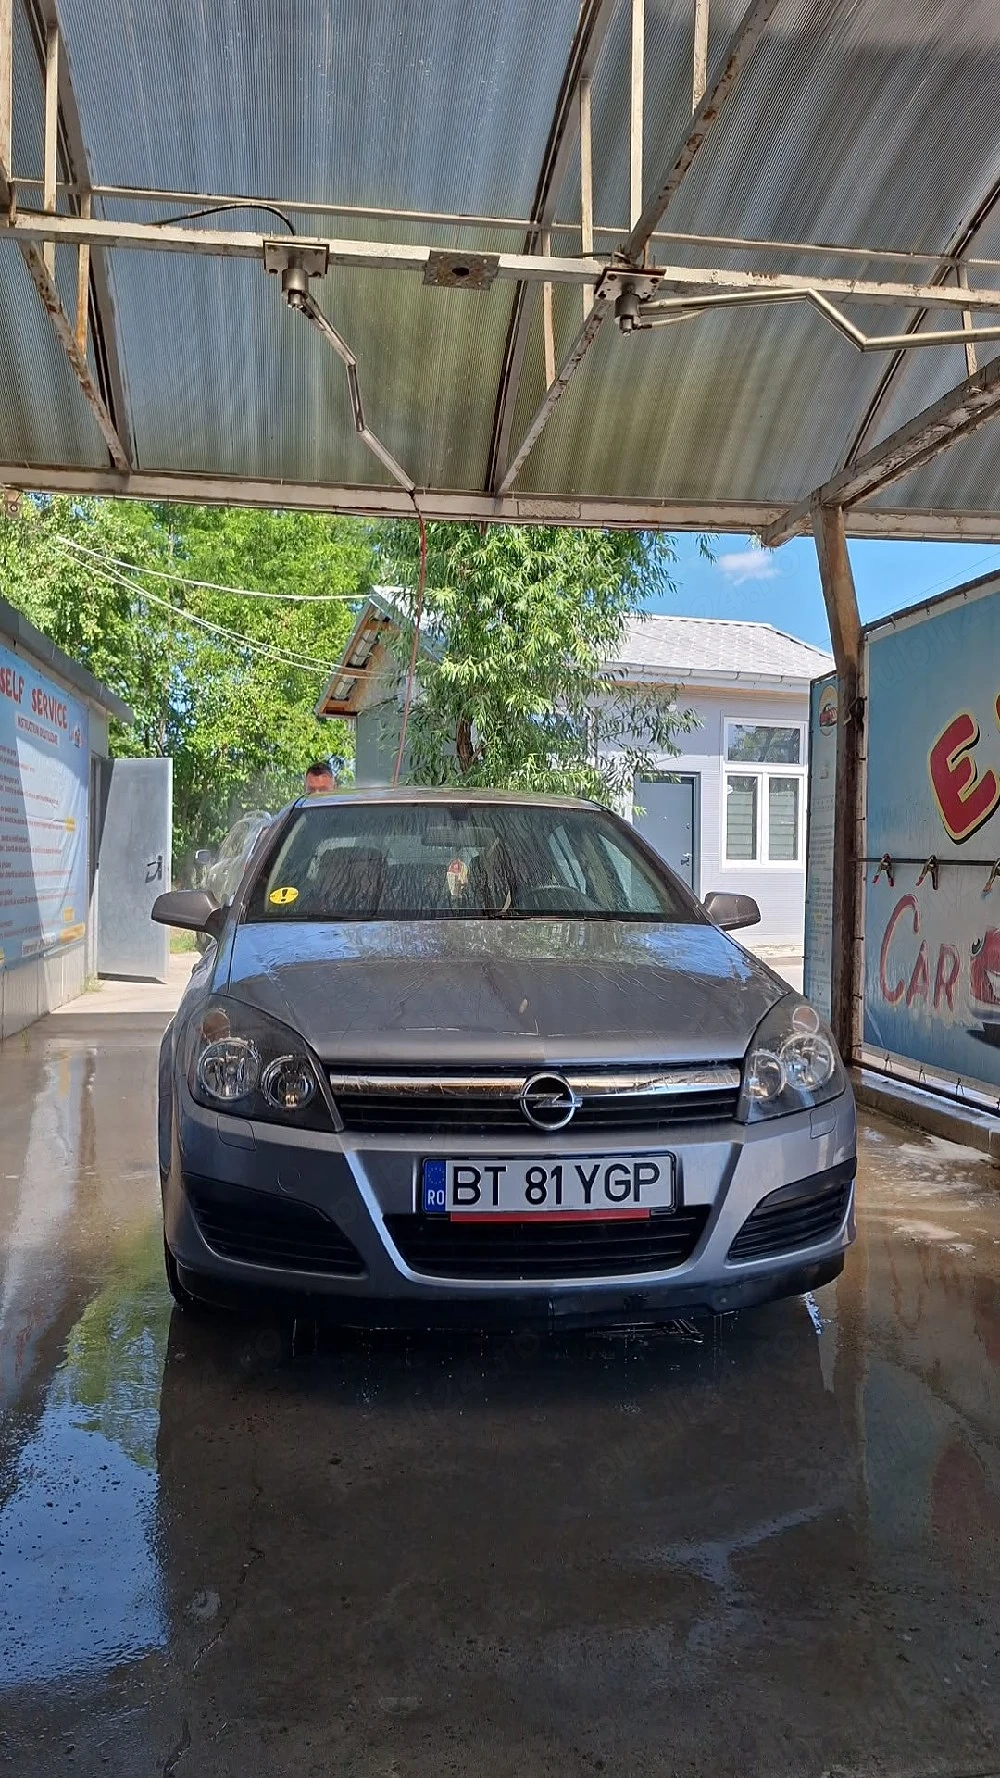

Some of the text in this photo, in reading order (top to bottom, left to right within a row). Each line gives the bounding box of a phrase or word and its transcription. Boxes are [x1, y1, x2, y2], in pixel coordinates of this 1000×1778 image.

[0, 666, 68, 729] SELF SERVICE
[929, 694, 1000, 845] E
[427, 1189, 445, 1206] RO
[452, 1162, 660, 1206] BT 81 YGP
